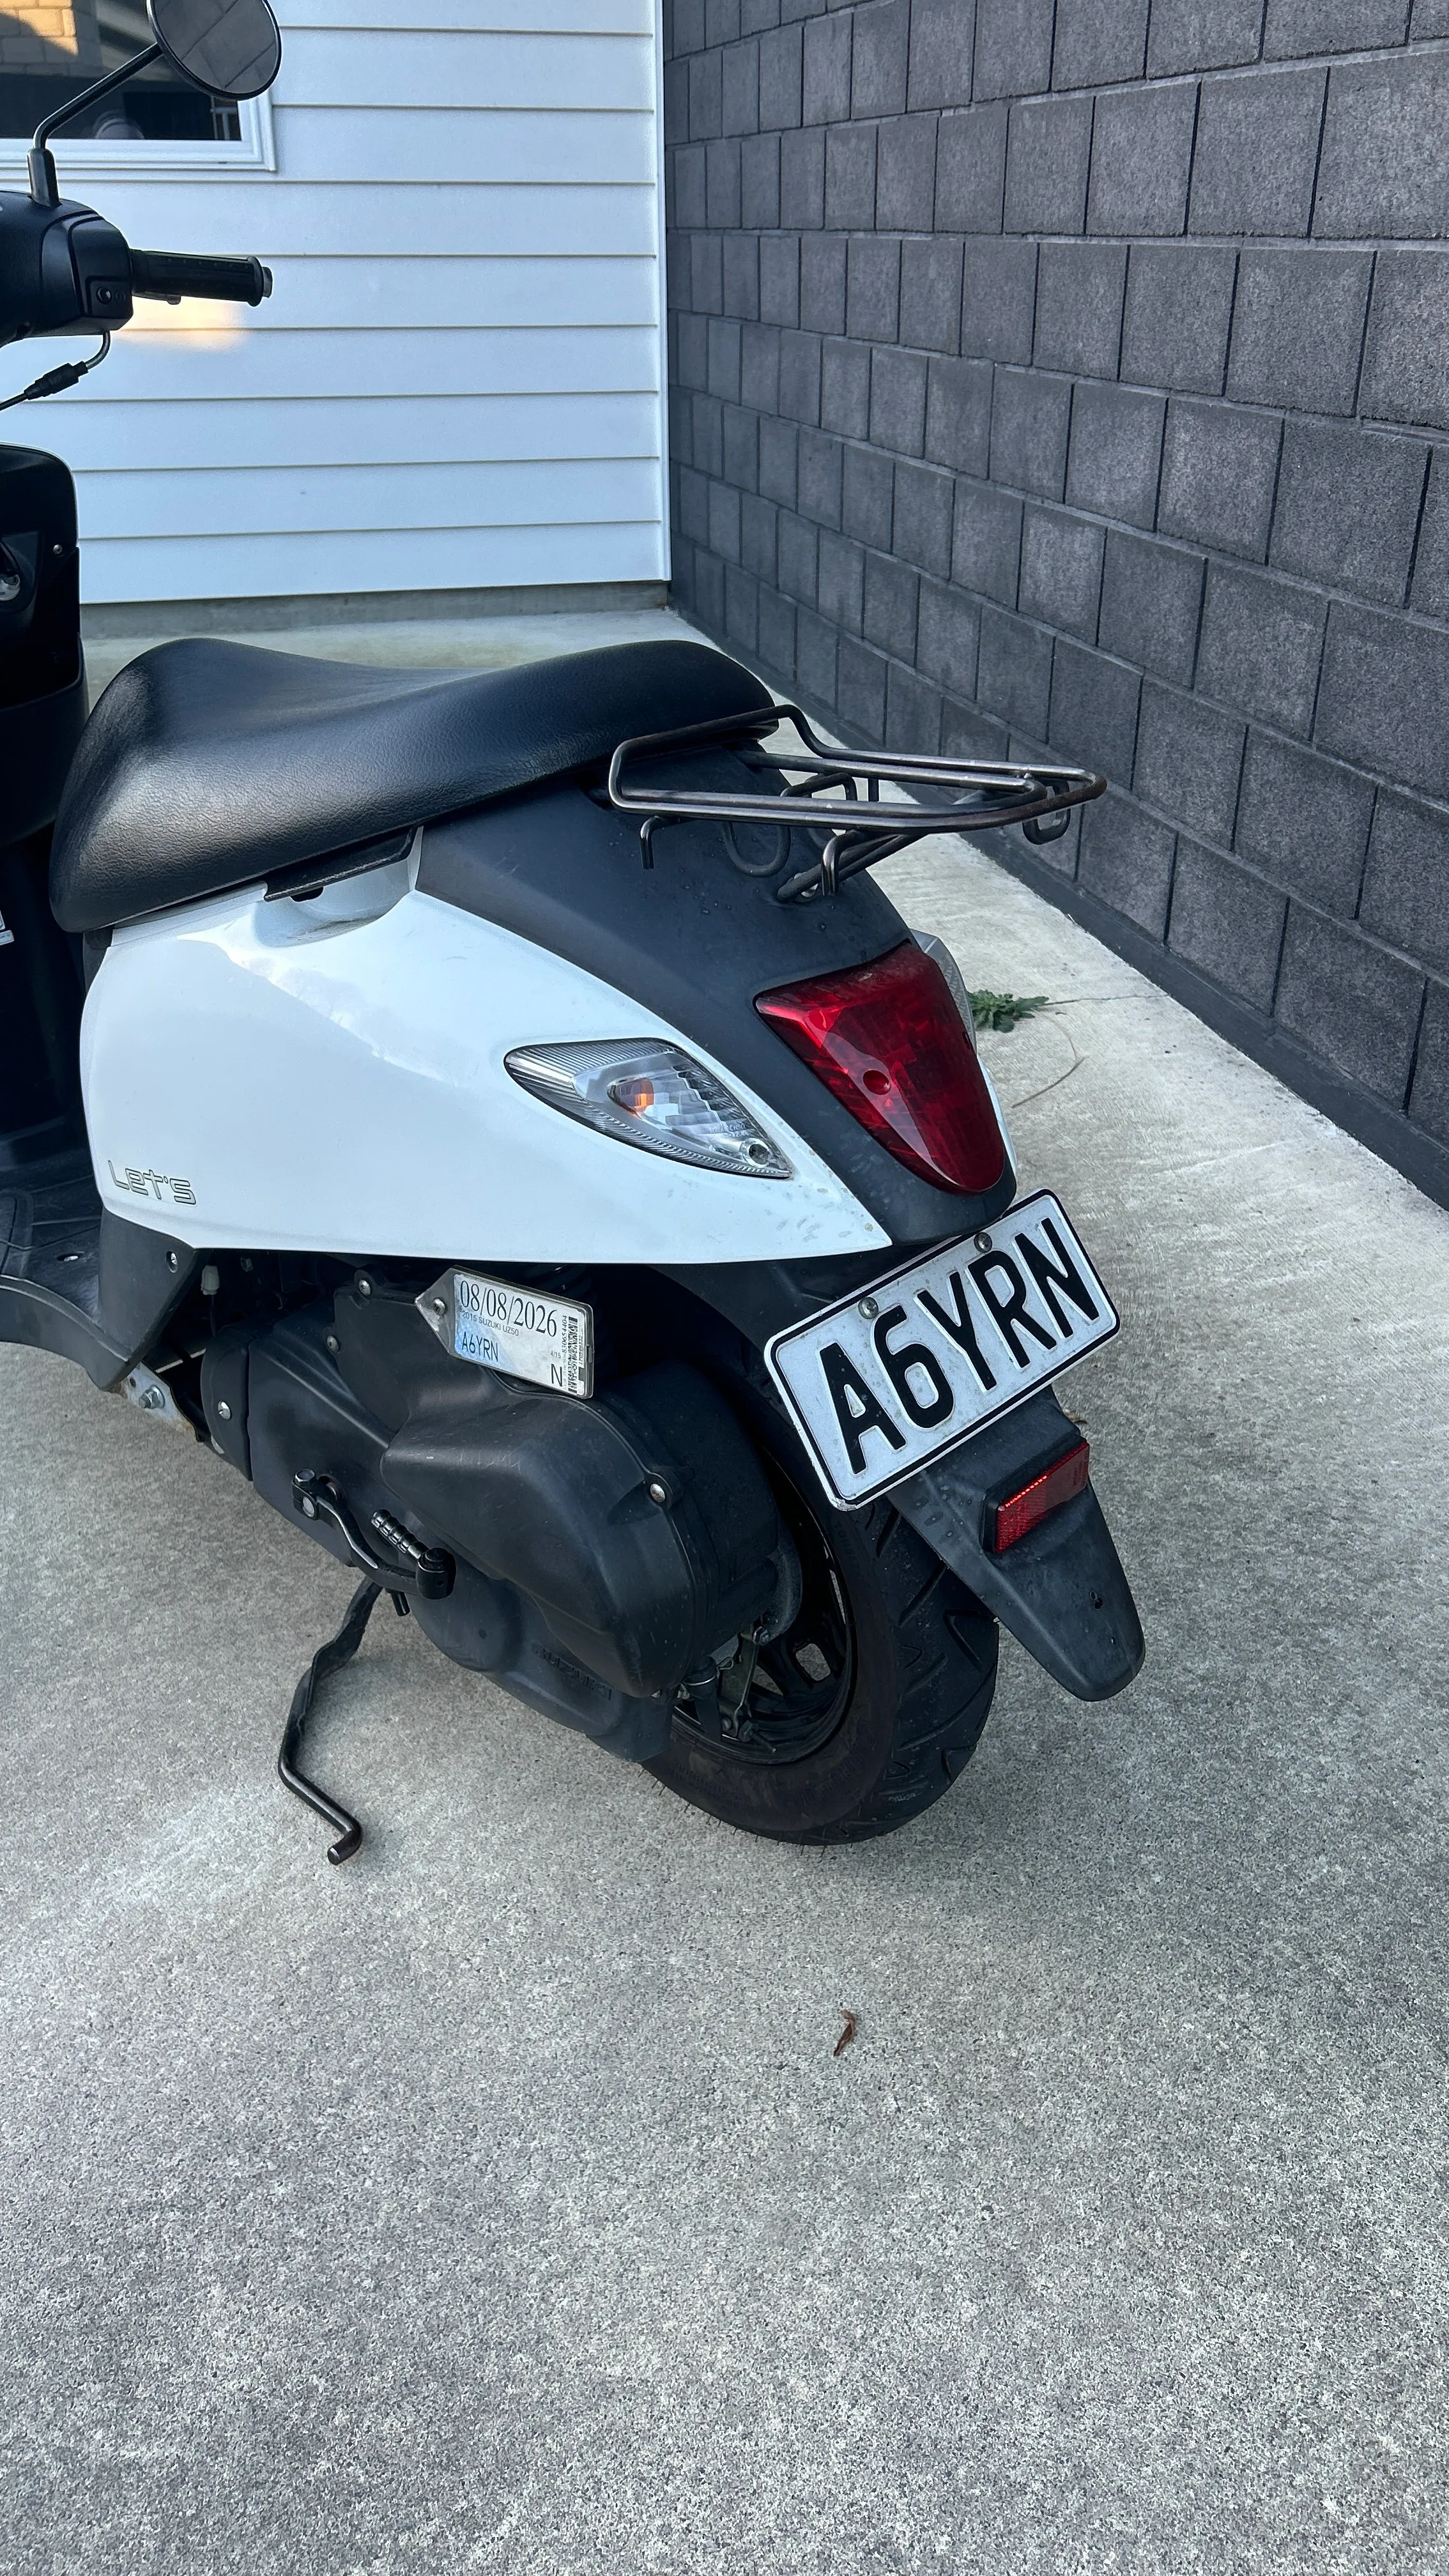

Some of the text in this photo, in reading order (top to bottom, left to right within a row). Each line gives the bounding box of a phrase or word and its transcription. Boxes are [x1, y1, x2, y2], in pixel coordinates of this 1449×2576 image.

[107, 1160, 196, 1205] Let's
[460, 1280, 558, 1337] 08/08/2026
[462, 1310, 519, 1337] 2015 SUZUKI UZ50
[461, 1331, 499, 1362] A6YRN
[819, 1217, 1100, 1475] A6YRN
[551, 1363, 563, 1387] N
[531, 1643, 613, 1701] SUZUKI
